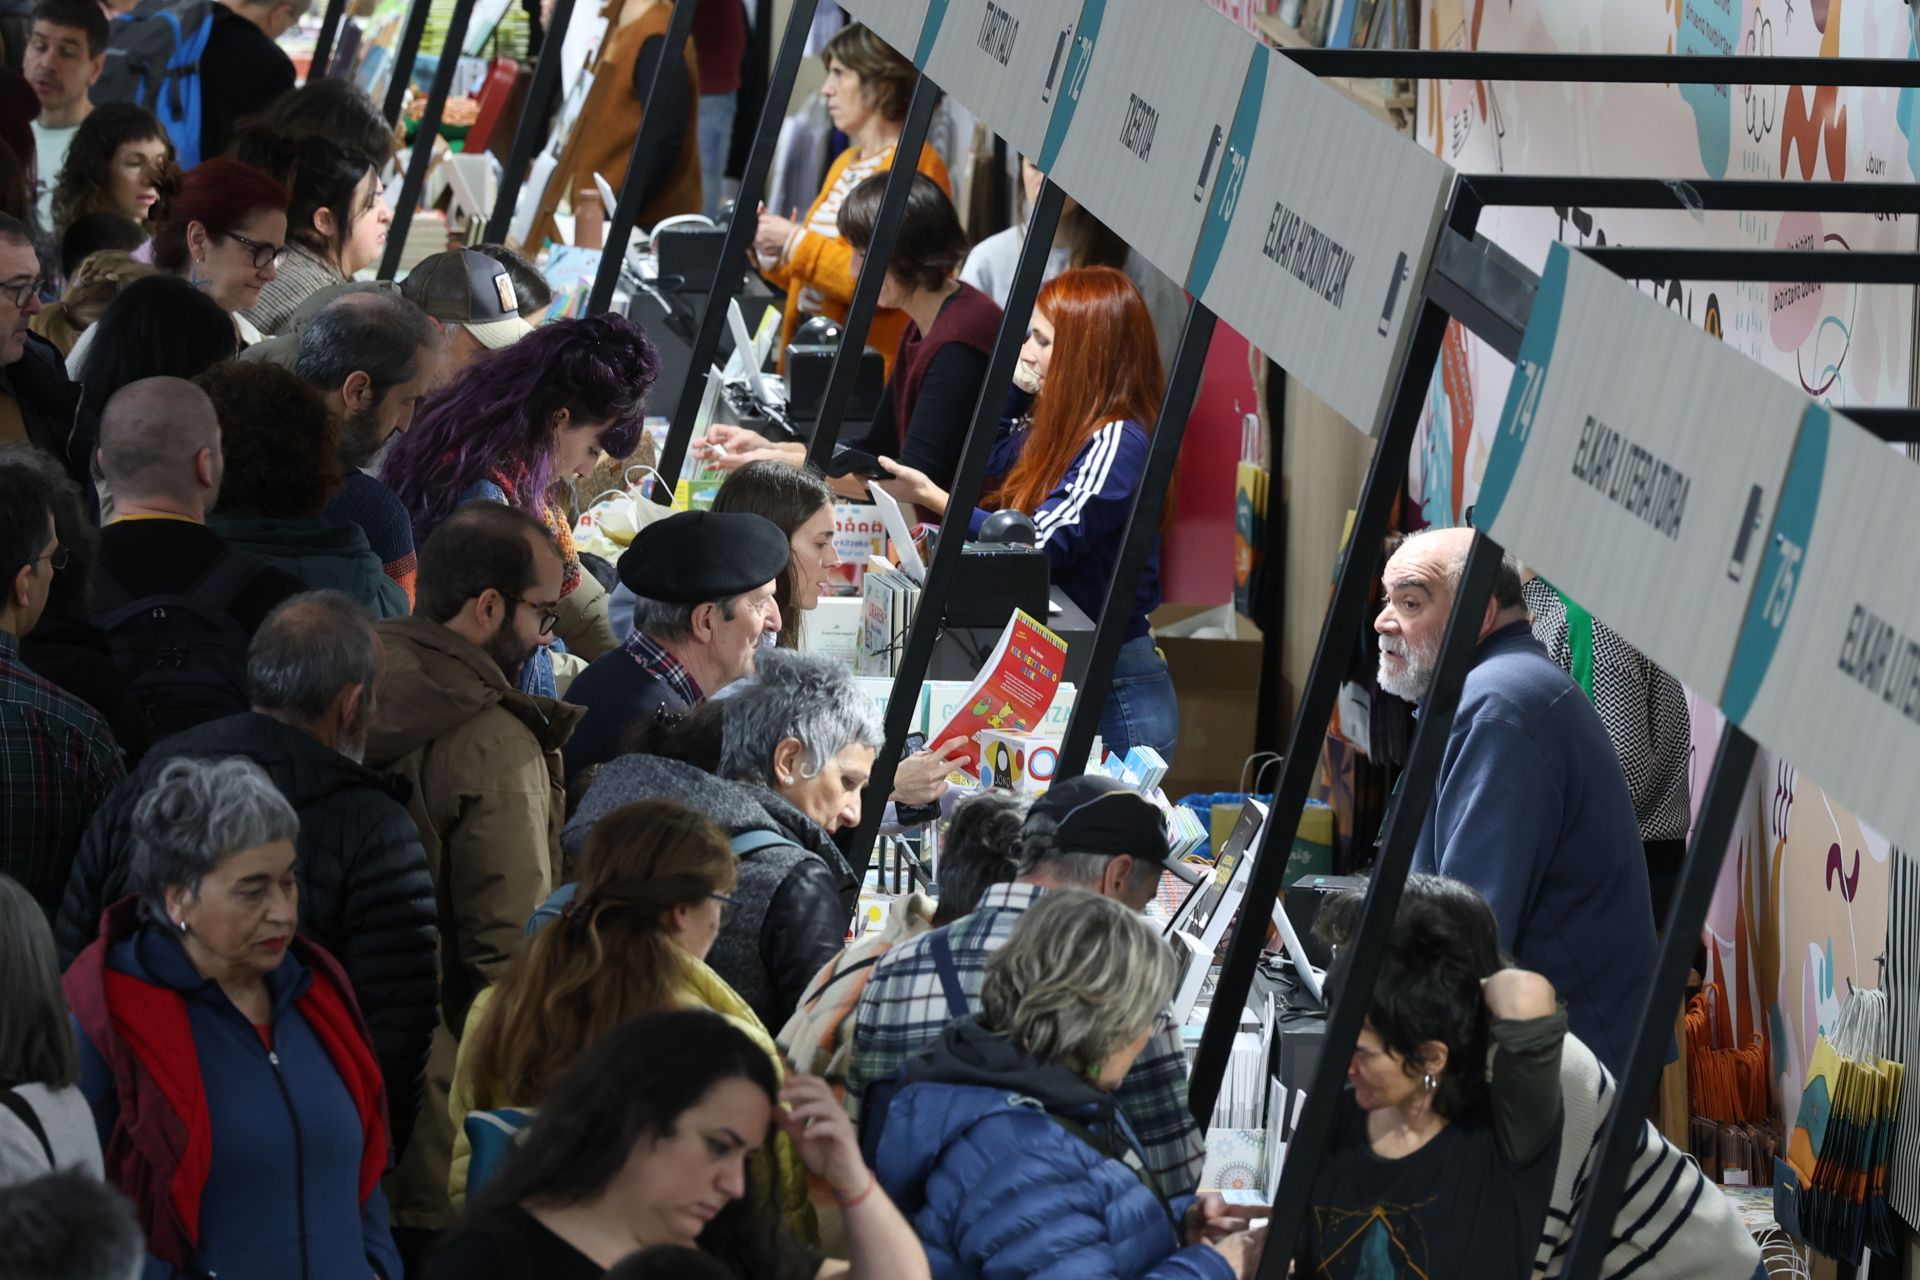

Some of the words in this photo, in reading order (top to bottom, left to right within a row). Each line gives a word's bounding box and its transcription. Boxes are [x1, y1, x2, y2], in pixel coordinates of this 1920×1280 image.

[976, 0, 1019, 68] TTARTTALO
[1068, 36, 1093, 102] 72
[1119, 92, 1160, 163] TXERTOA
[1218, 152, 1246, 222] 73
[1262, 201, 1301, 270] ELKAR
[1290, 221, 1355, 310] HIZKUNTZAK
[1509, 361, 1545, 442] 74
[1571, 414, 1620, 495] ELKAR
[1609, 438, 1691, 541] LITERATURA
[1762, 538, 1803, 628] 75
[1838, 603, 1894, 696] ELKAR
[994, 773, 1011, 788] JOKO
